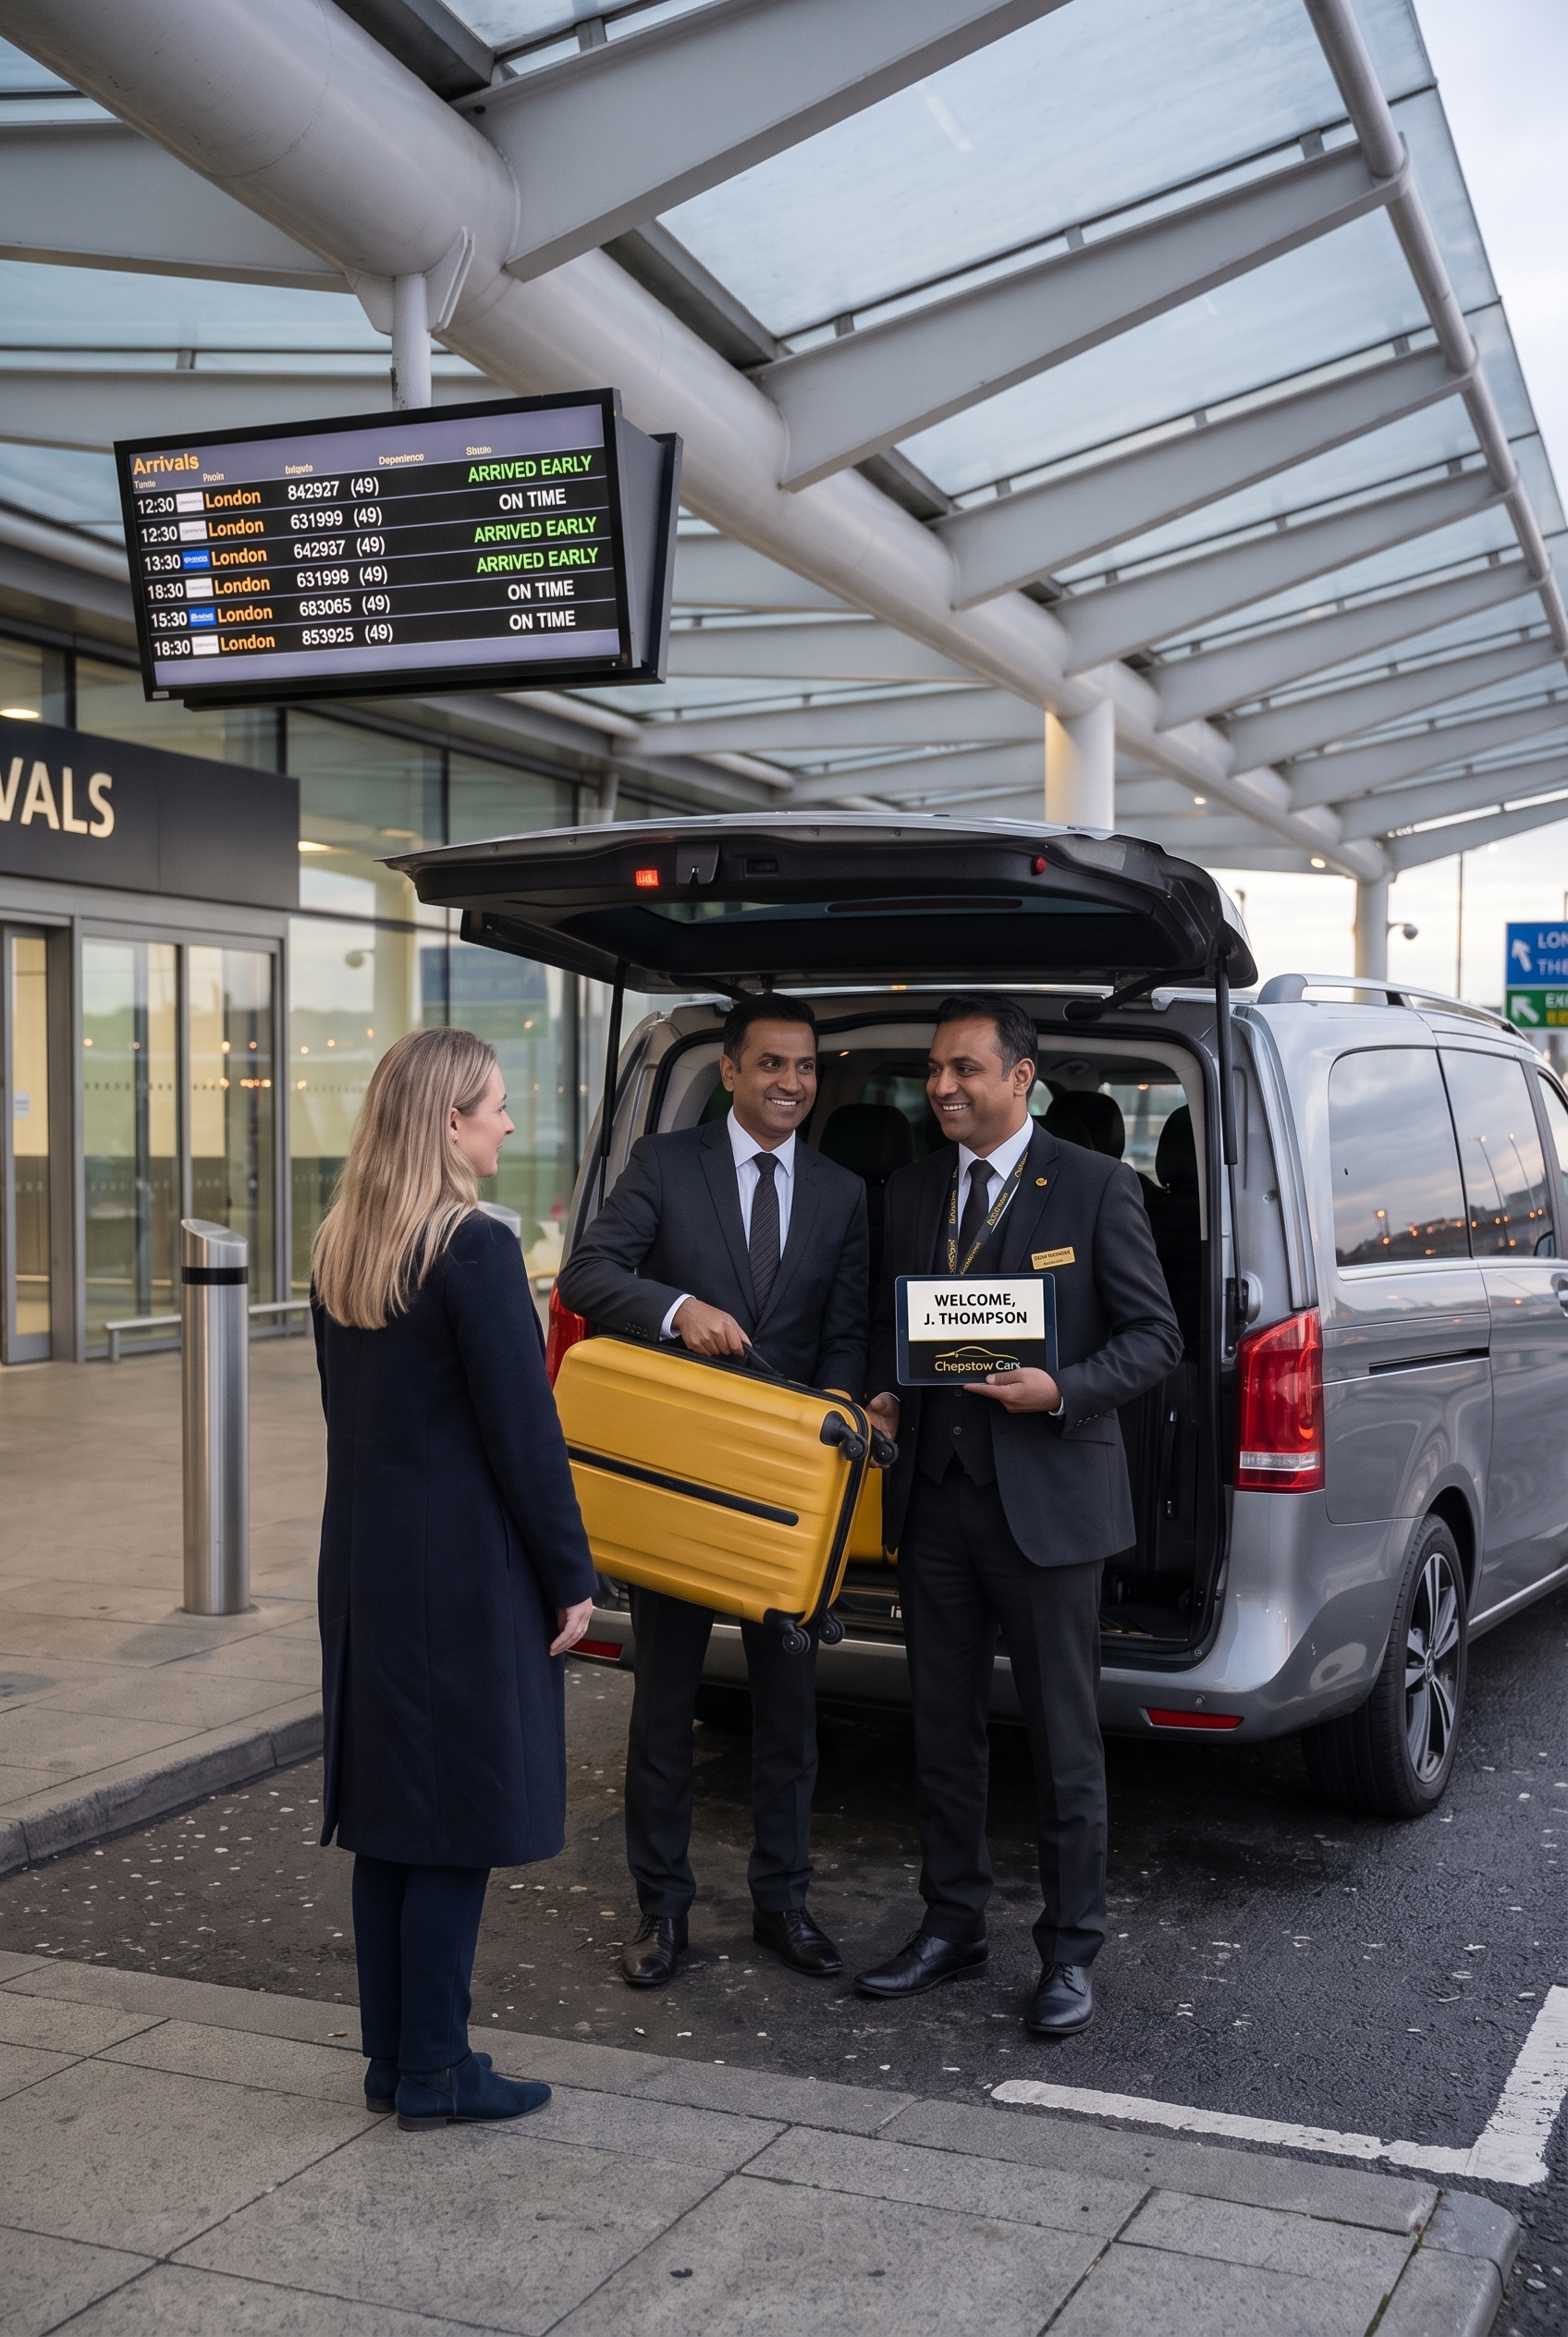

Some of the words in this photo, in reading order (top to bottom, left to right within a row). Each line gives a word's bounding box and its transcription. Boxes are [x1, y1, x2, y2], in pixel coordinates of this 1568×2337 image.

[133, 453, 200, 475] Arrivals
[138, 496, 174, 514] 12:30
[205, 489, 261, 508] London
[350, 477, 379, 497] (49)
[468, 460, 536, 483] ARRIVED
[541, 455, 592, 475] EARLY
[141, 526, 178, 543] 12:30
[208, 519, 264, 537] London
[290, 510, 343, 530] 631999
[354, 507, 383, 527] (49)
[499, 493, 523, 510] ON
[527, 488, 566, 508] TIME
[144, 554, 181, 571] 13:30
[212, 548, 267, 566] London
[357, 536, 386, 557] (49)
[474, 521, 542, 543] ARRIVED
[546, 516, 597, 536] EARLY
[148, 582, 184, 599] 18:30
[214, 577, 270, 594] London
[360, 565, 387, 586] (49)
[476, 552, 544, 573] ARRIVED
[549, 547, 598, 567] EARLY
[152, 612, 187, 628] 15:30
[217, 606, 273, 623] London
[300, 598, 351, 617] 683065
[362, 594, 390, 615] (49)
[508, 583, 532, 600] ON
[535, 580, 574, 597] TIME
[154, 640, 190, 656] 18:30
[220, 634, 276, 652] London
[302, 627, 354, 645] 853925
[365, 623, 393, 643] (49)
[509, 614, 533, 630] ON
[536, 610, 576, 628] TIME
[925, 1314, 935, 1325] J.
[939, 1312, 1027, 1325] THOMPSON
[935, 1293, 1015, 1307] WELCOME,
[935, 1361, 993, 1373] Chepstow
